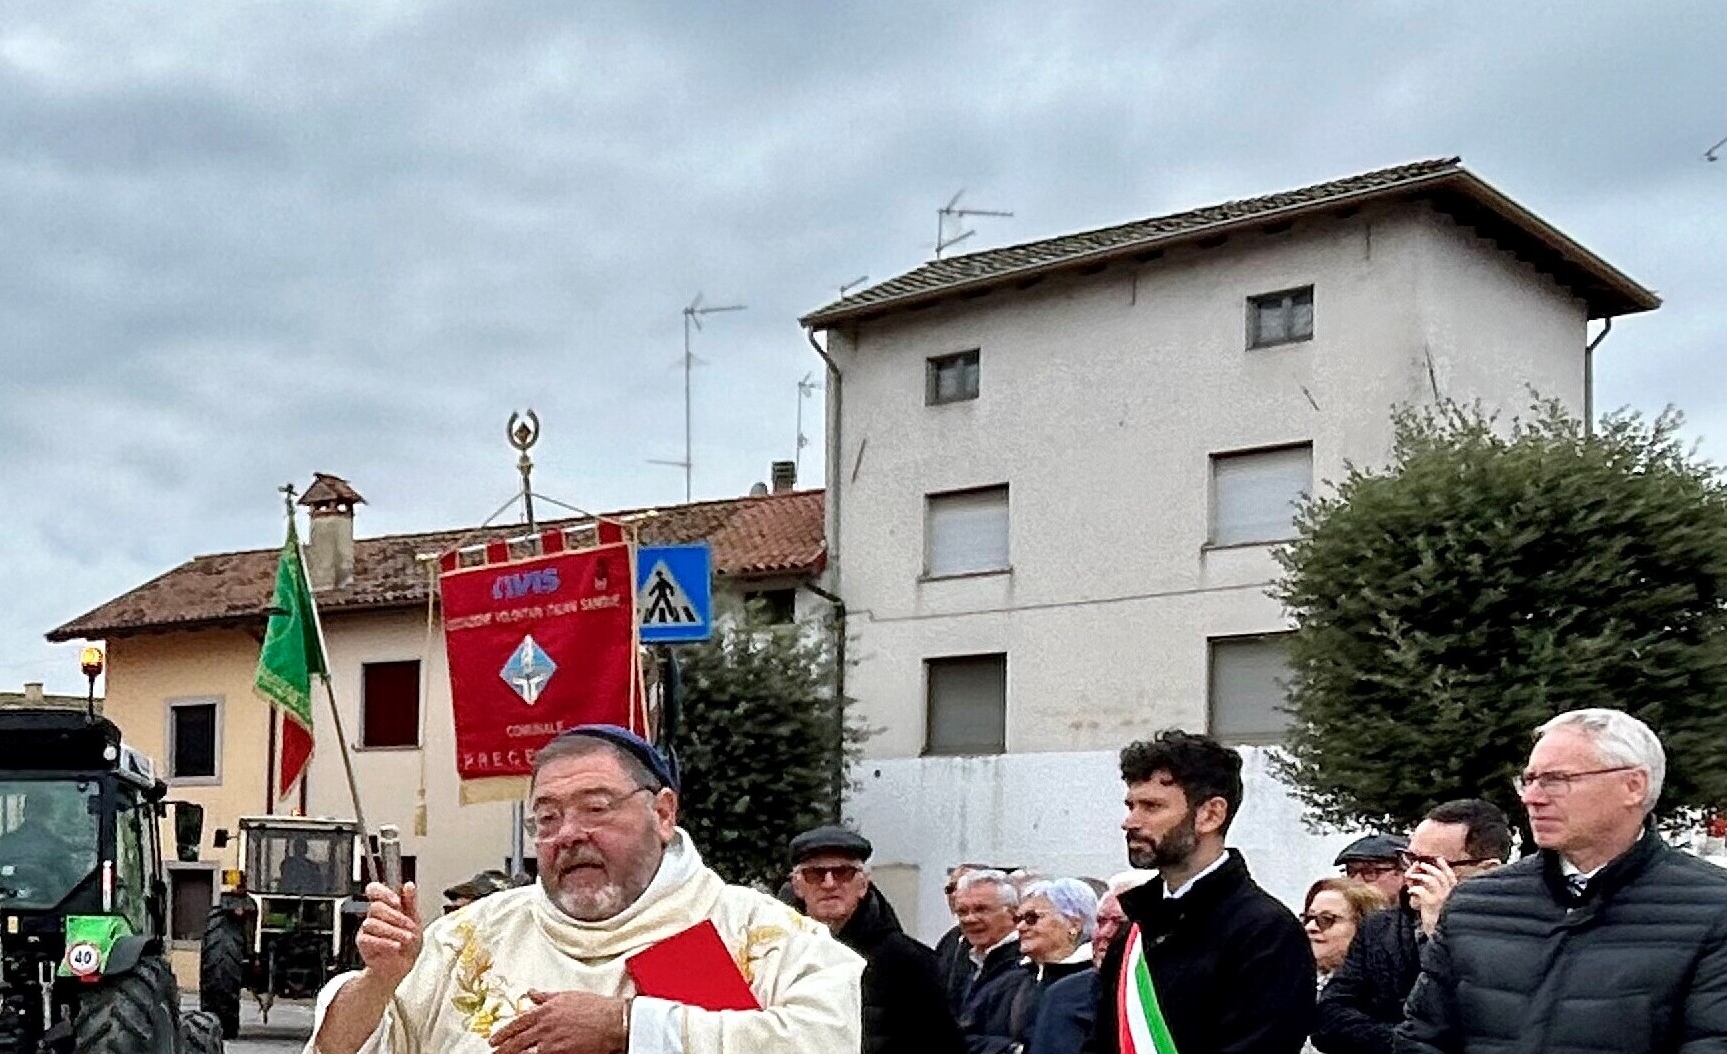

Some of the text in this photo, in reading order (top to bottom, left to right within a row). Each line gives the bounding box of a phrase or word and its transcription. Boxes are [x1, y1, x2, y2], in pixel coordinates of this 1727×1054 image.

[492, 568, 560, 600] AVIS
[463, 748, 536, 771] PRECE
[74, 950, 92, 965] 40
